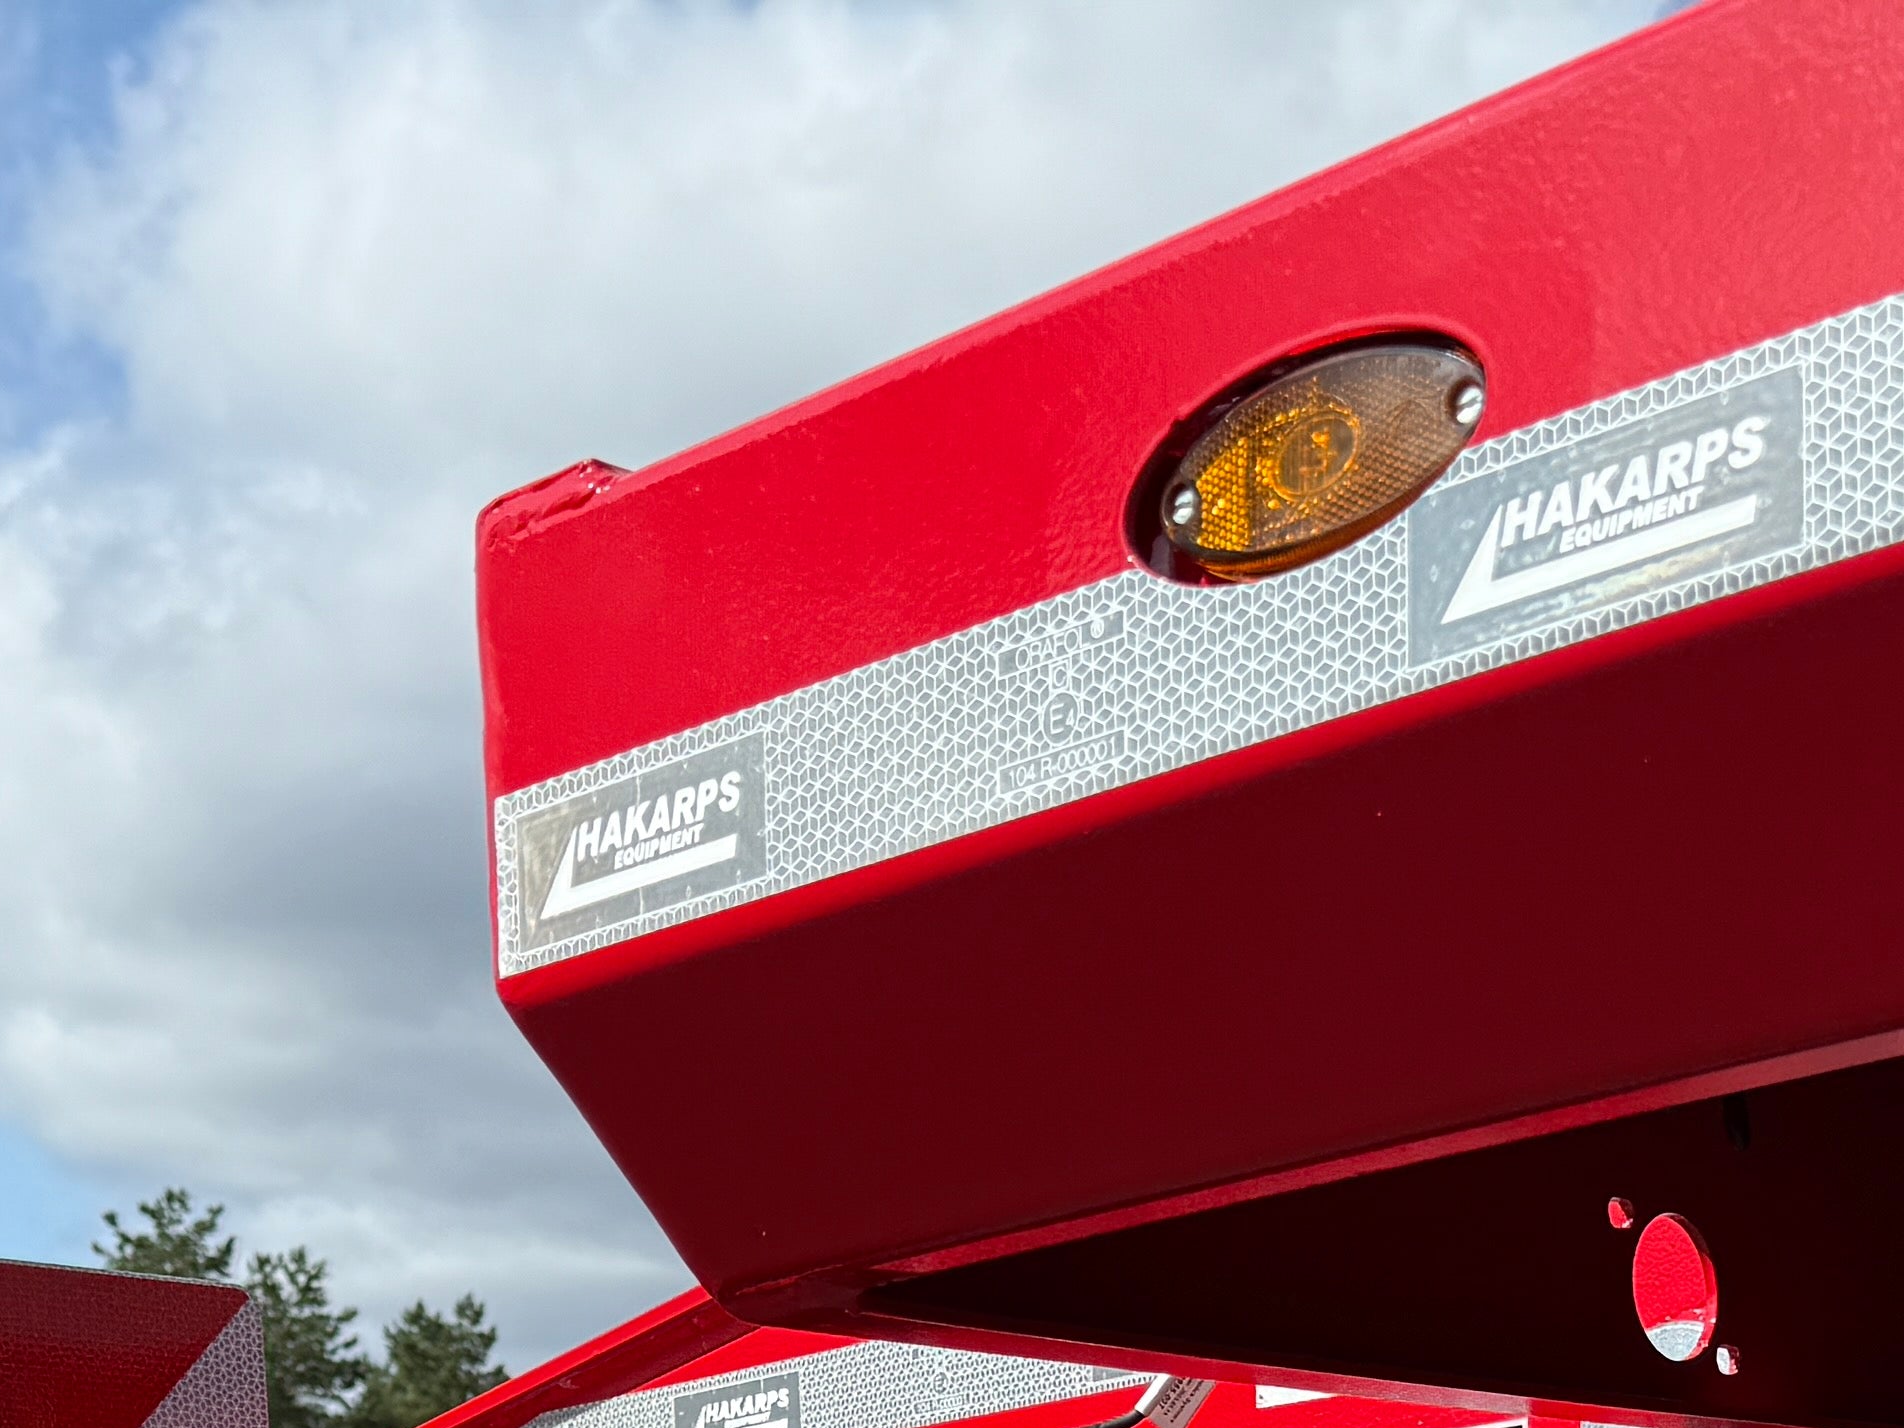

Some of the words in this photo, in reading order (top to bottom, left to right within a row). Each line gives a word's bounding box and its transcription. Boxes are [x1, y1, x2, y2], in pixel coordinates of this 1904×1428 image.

[1502, 415, 1769, 548] HAKARPS
[1559, 485, 1703, 554] EQUIPMENT
[577, 770, 742, 863] HAKARPS
[613, 822, 704, 871] EQUIPMENT
[705, 1387, 790, 1423] HAKARPS
